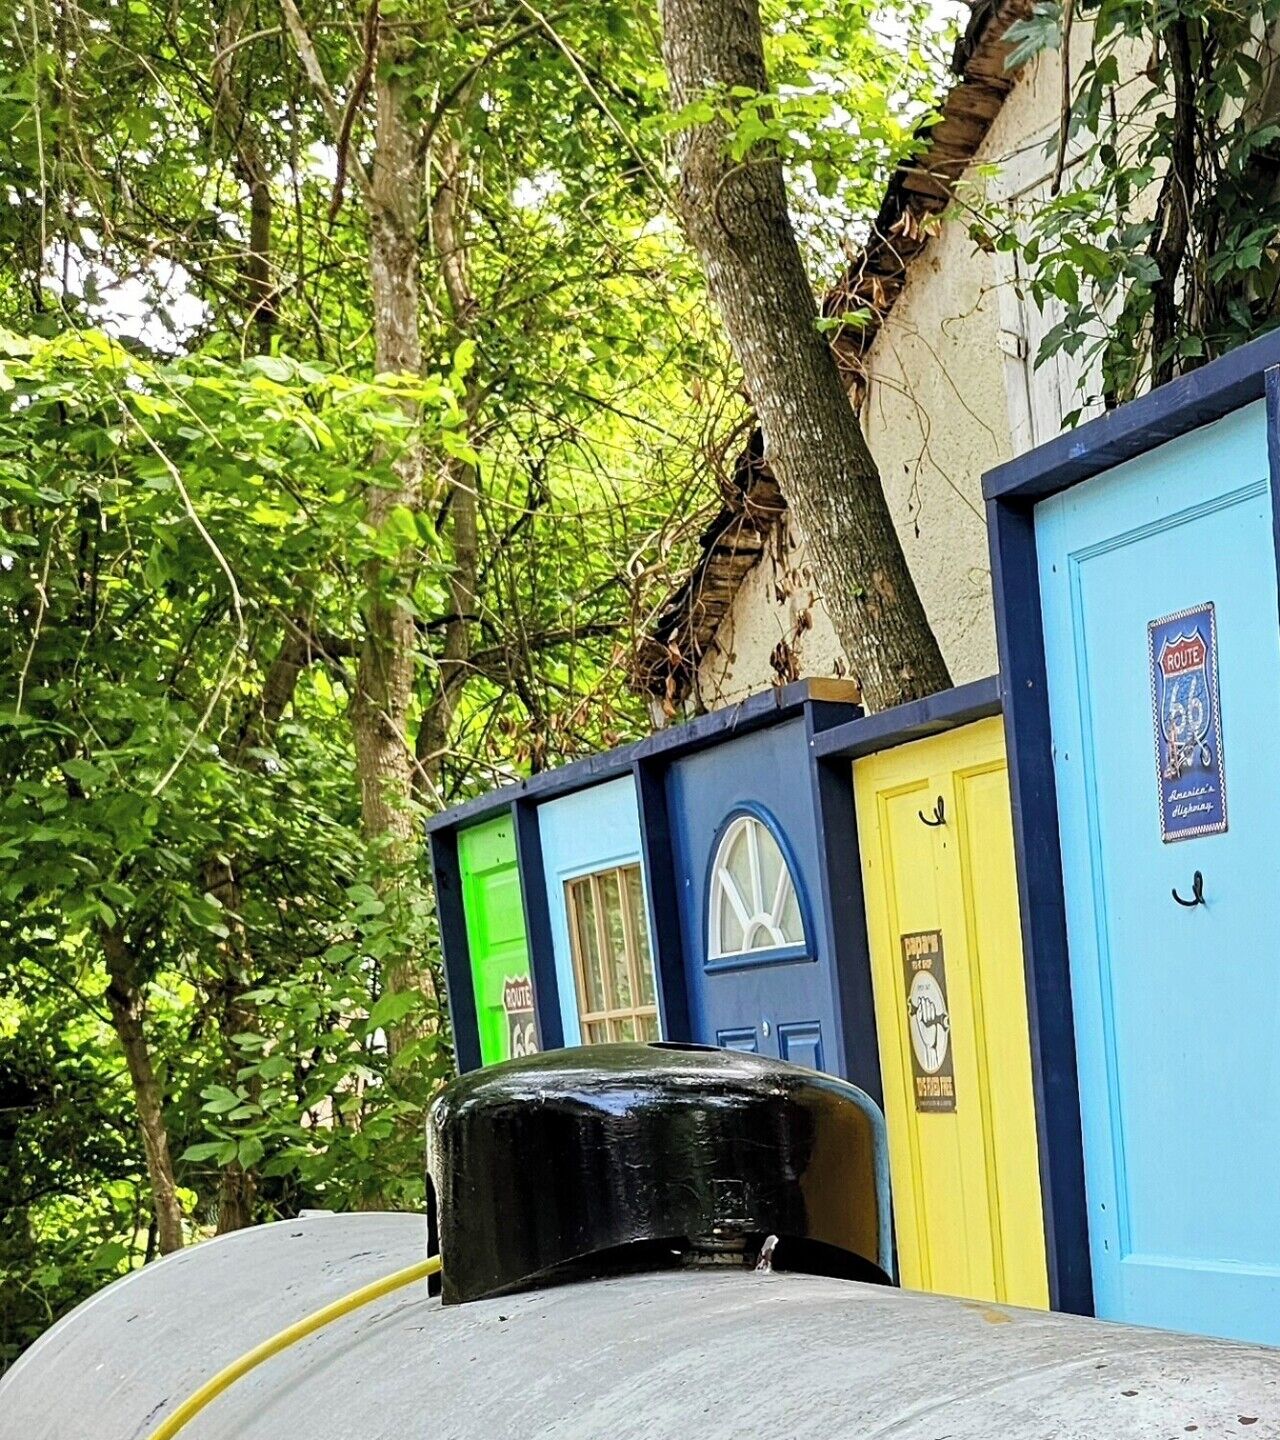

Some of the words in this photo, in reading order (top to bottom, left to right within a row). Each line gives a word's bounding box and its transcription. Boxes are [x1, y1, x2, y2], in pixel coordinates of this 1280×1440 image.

[1166, 644, 1201, 671] ROUTE
[1168, 674, 1204, 738] 66
[1167, 782, 1216, 803] America's
[505, 985, 532, 1009] ROUTE
[513, 1023, 538, 1059] 66
